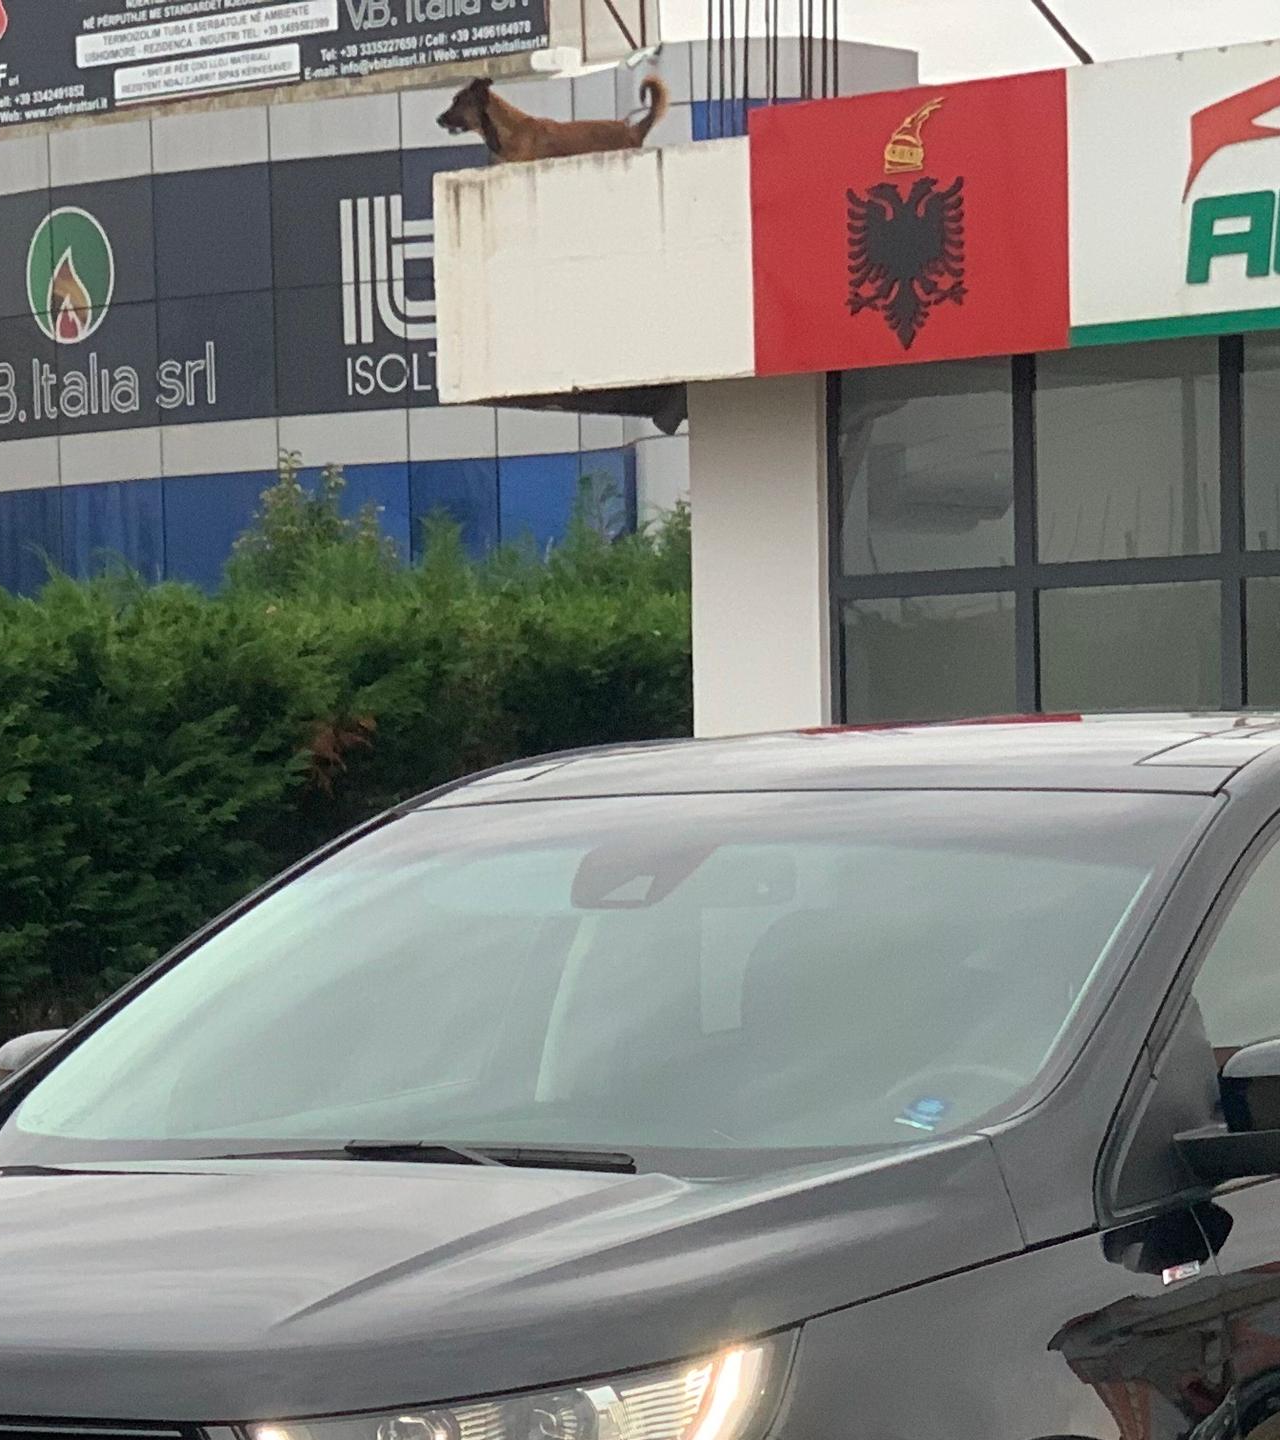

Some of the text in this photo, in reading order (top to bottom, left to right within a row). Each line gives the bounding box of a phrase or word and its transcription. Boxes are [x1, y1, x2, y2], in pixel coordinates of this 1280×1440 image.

[264, 5, 309, 21] AMBIENTE
[340, 44, 358, 57] +39
[450, 28, 469, 43] +39
[14, 92, 31, 106] +39
[155, 341, 217, 410] srl
[346, 352, 438, 396] ISOL
